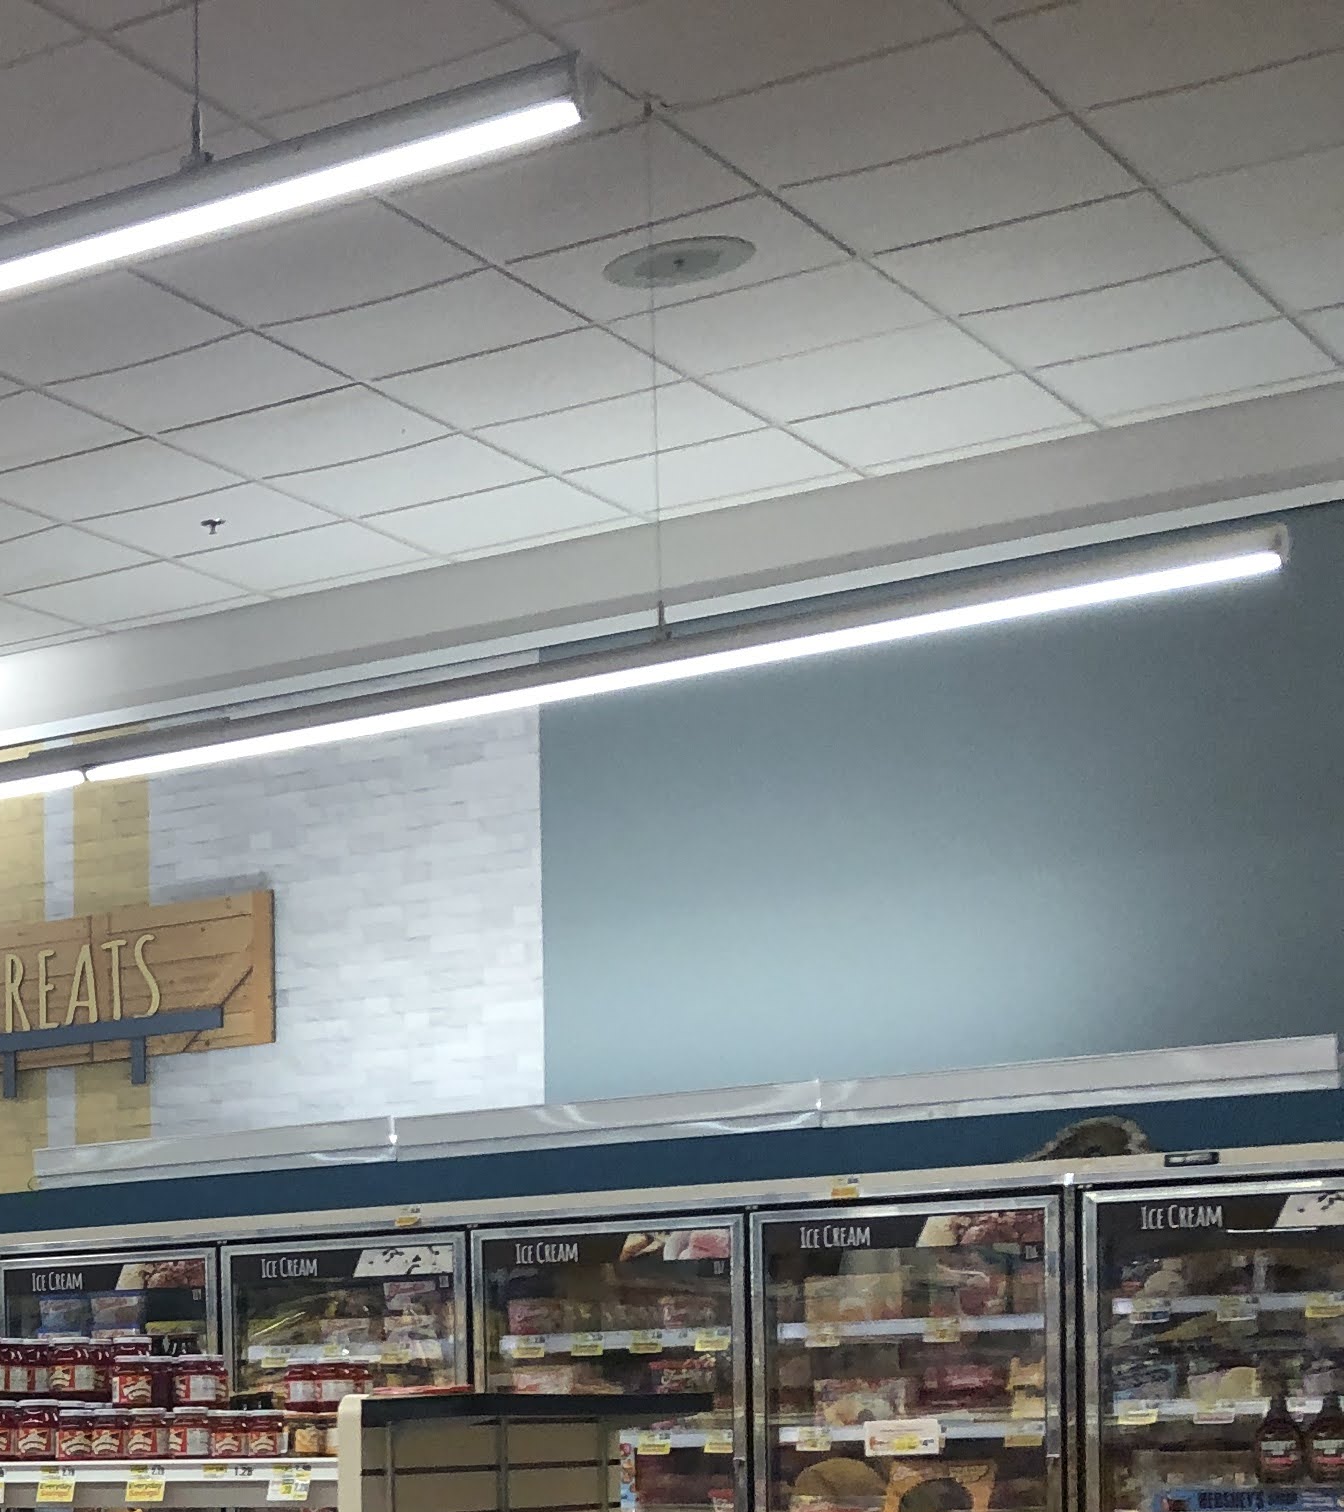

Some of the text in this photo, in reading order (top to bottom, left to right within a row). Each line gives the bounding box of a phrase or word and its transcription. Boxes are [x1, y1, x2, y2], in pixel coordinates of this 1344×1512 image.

[1168, 1204, 1223, 1229] CREAM
[823, 1225, 871, 1247] CREAM
[536, 1242, 579, 1263] CREAM
[279, 1257, 318, 1278] CREAM
[48, 1271, 83, 1291] CREAM
